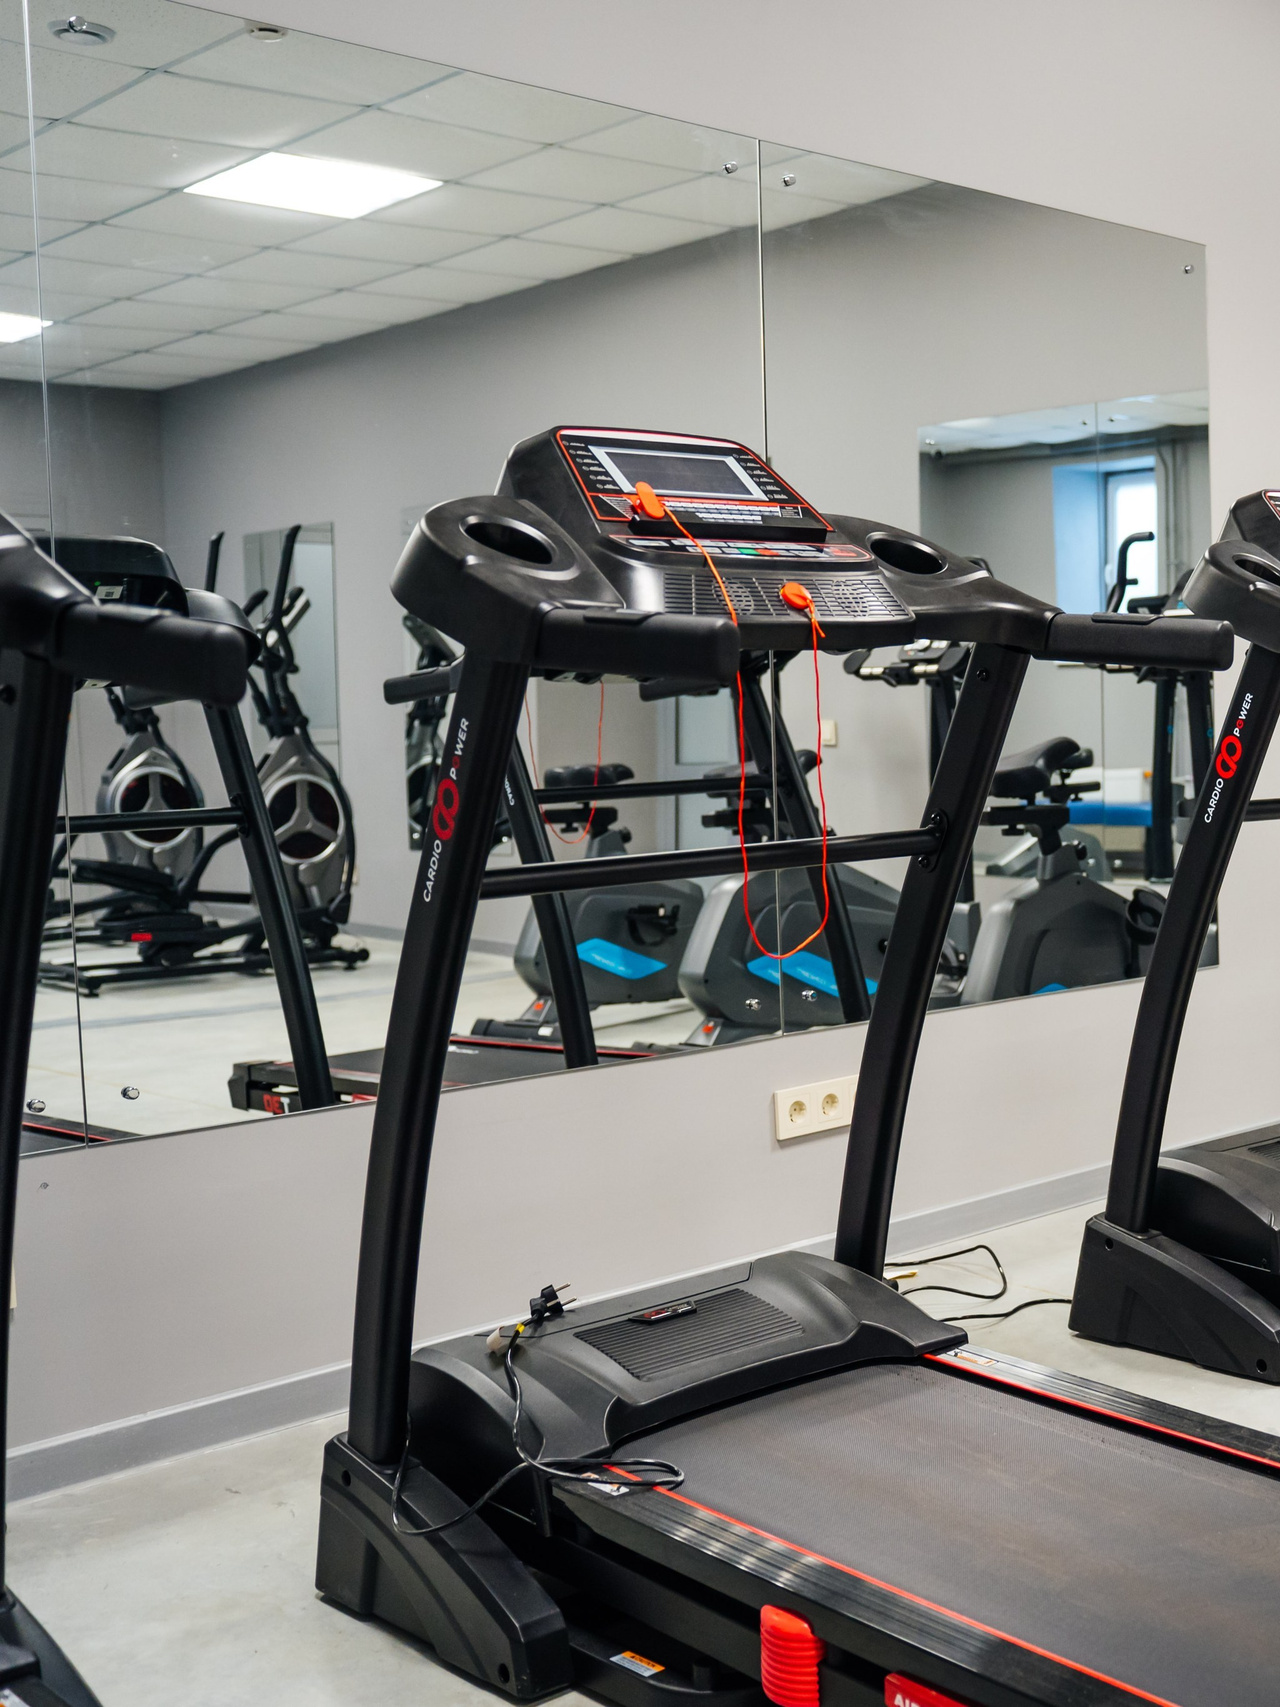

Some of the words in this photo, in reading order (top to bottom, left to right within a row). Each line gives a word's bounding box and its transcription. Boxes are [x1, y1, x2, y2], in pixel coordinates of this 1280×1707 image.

[423, 839, 442, 903] CARDIO
[449, 717, 470, 780] POWER
[1204, 778, 1224, 823] CARDIO
[1233, 692, 1254, 737] POWER
